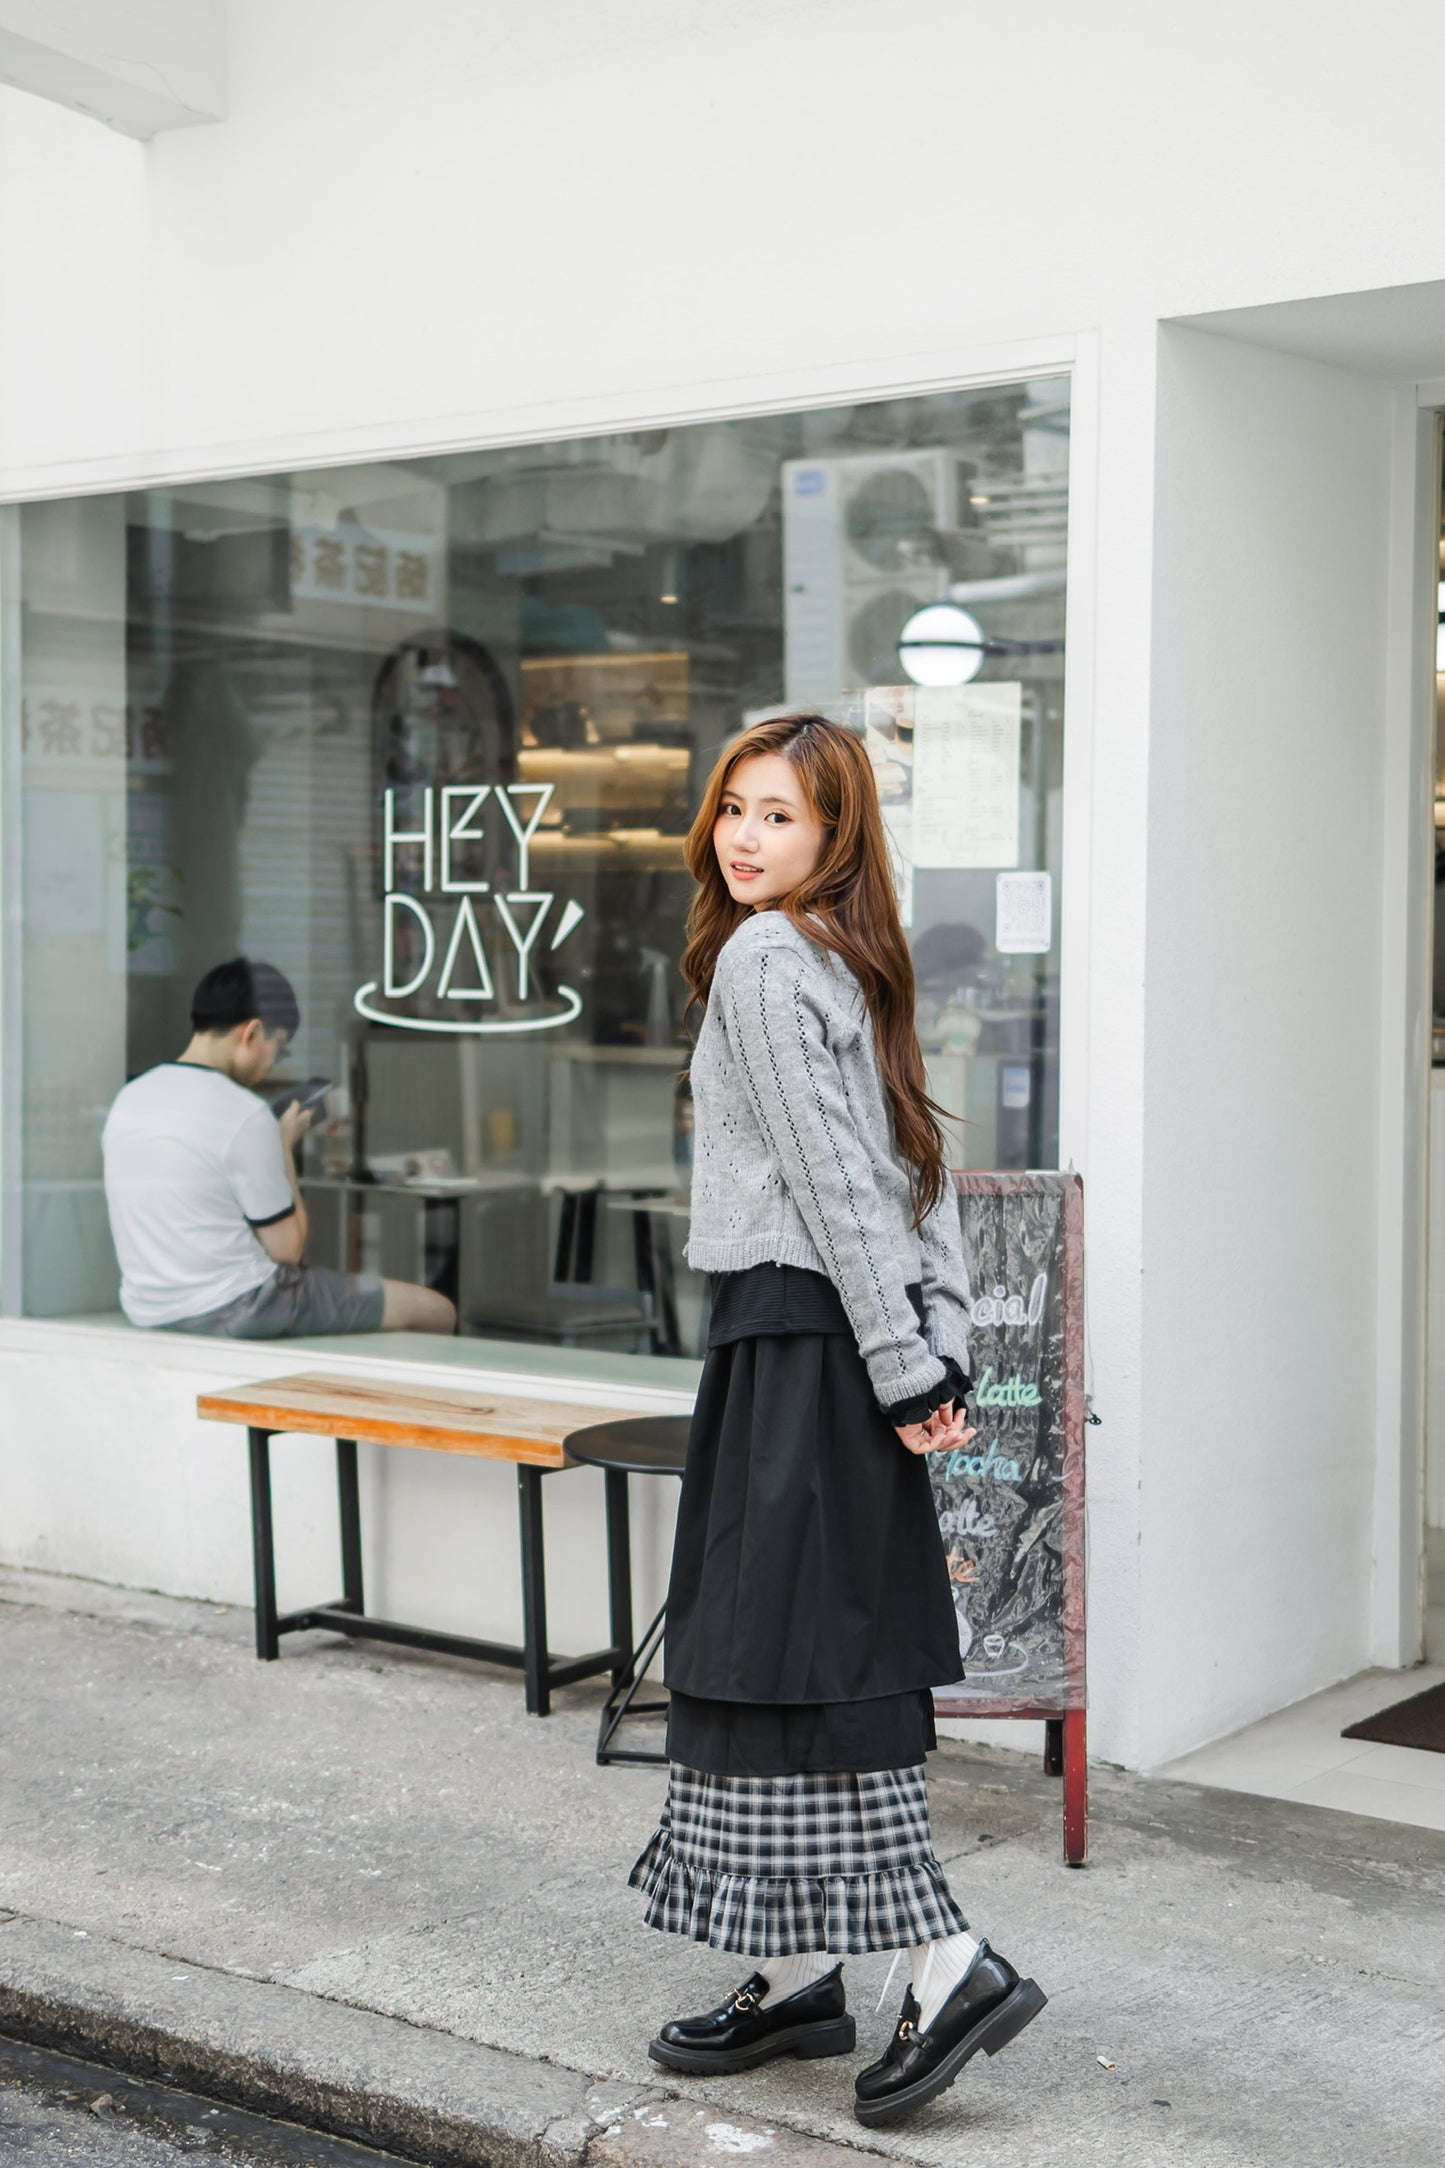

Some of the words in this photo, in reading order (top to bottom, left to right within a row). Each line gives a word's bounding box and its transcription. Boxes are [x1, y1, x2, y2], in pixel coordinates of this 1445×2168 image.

[384, 783, 554, 893] HEY
[970, 1272, 1048, 1327] cial
[938, 1498, 997, 1538] atte
